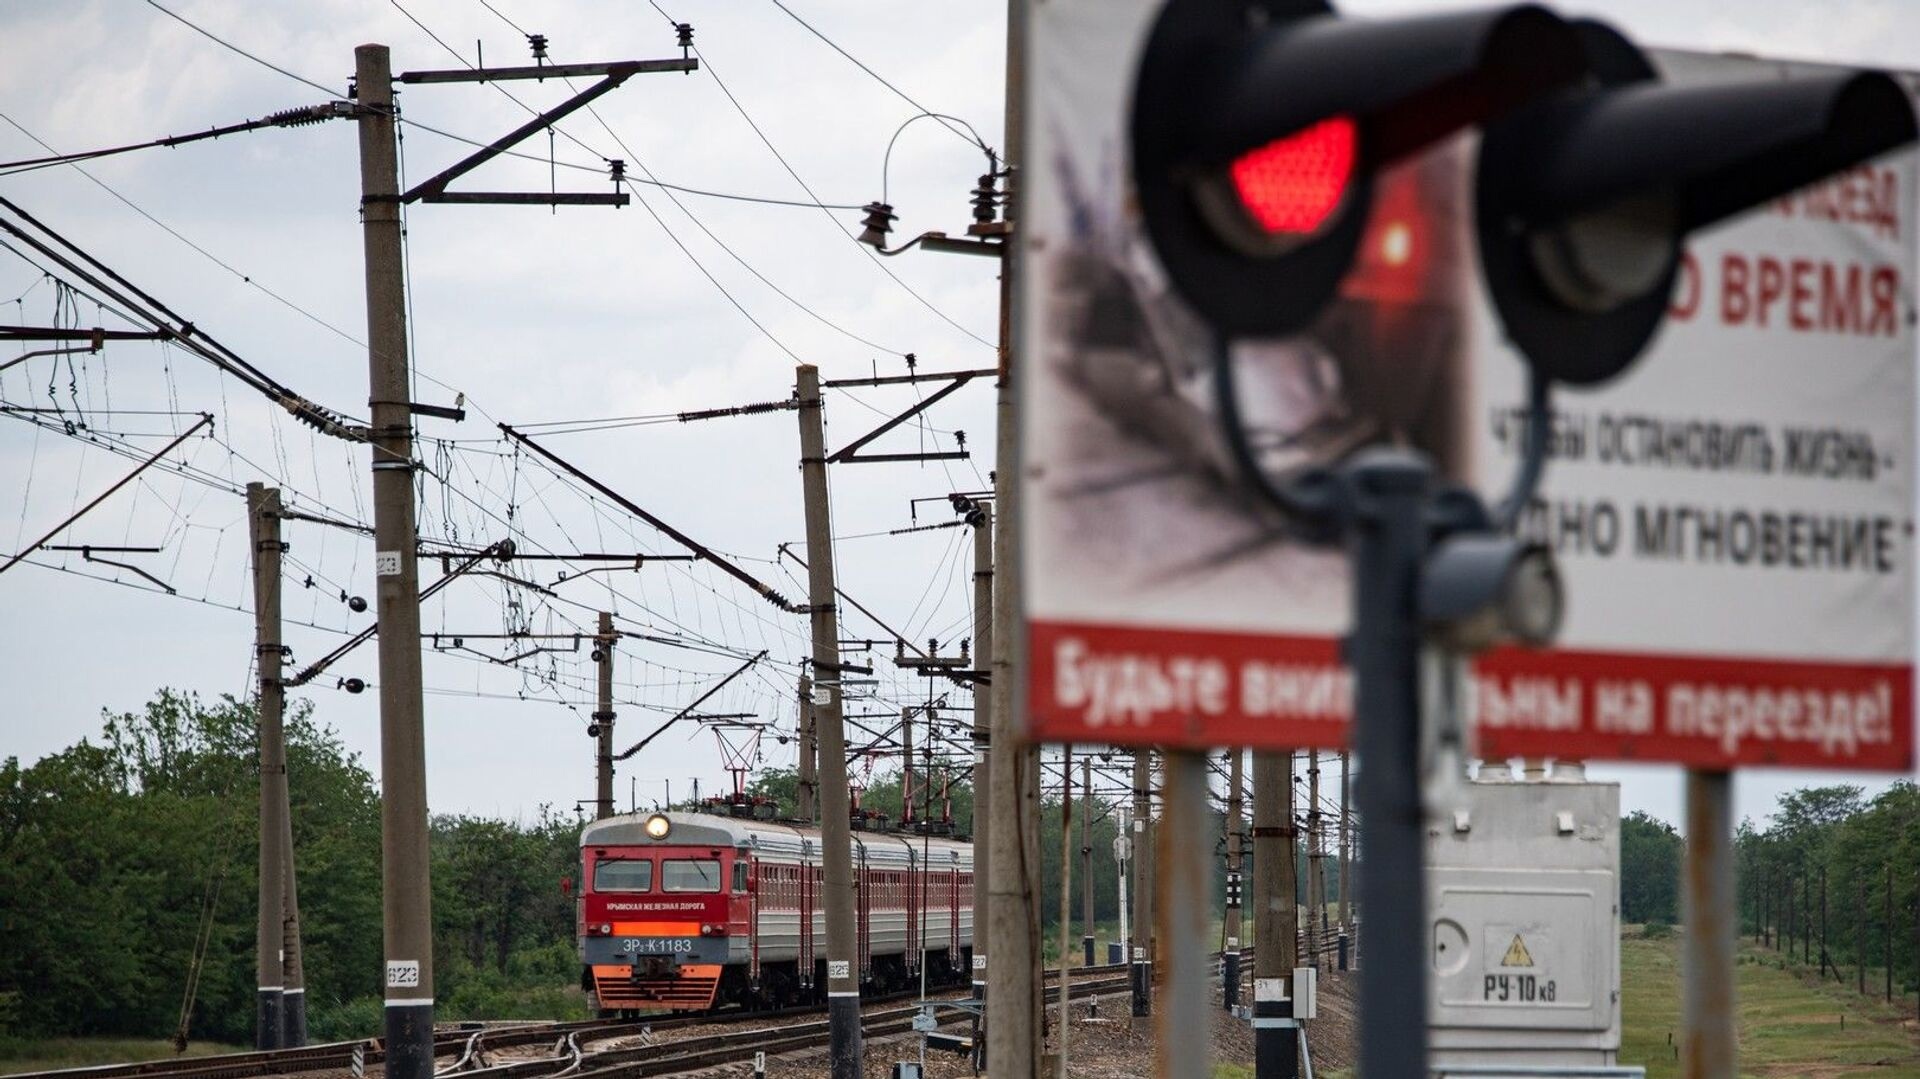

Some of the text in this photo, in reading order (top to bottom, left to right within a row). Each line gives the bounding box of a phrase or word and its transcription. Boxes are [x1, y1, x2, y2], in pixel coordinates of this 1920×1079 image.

[1719, 250, 1898, 338] ВРЕМЯ
[1490, 407, 1587, 461] ЧТБЫ
[1598, 412, 1773, 473] ОСТАНОВИТЬ
[1519, 498, 1894, 573] ДНО МГНОВЕНИЕ
[1055, 637, 1230, 728] Будьте
[1594, 679, 1654, 735] на
[1667, 679, 1893, 755] переезде!
[606, 901, 706, 911] КРЫМСКАЯ ЖЕЛЕЗНАЯ ДОРОГА
[1484, 974, 1536, 1001] РУ-10
